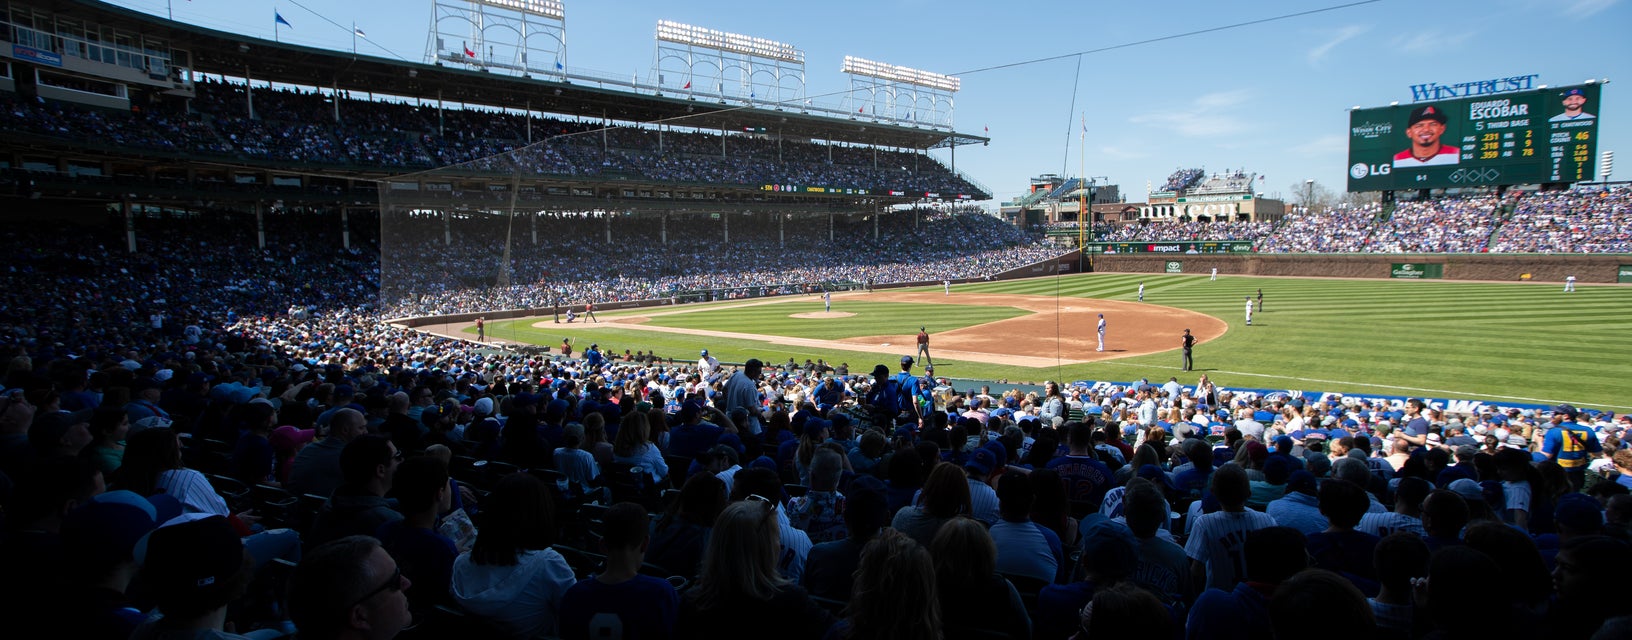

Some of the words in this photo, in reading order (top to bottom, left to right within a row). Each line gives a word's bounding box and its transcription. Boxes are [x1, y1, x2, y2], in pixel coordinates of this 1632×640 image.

[1409, 74, 1538, 101] WINTRUST
[1471, 99, 1510, 110] EDUARDO
[1470, 104, 1528, 120] ESCOBAR
[1476, 121, 1484, 131] 5
[1487, 121, 1509, 129] THIRD
[1510, 119, 1530, 127] BASE
[1481, 133, 1499, 141] .231
[1526, 130, 1533, 138] 2
[1575, 132, 1589, 140] 46
[1481, 142, 1499, 151] .318
[1480, 151, 1499, 160] .359
[1522, 148, 1534, 157] 78
[1370, 163, 1391, 176] LG
[1136, 203, 1239, 220] nuveen
[1153, 244, 1181, 253] impact
[1392, 269, 1424, 277] Gallagher
